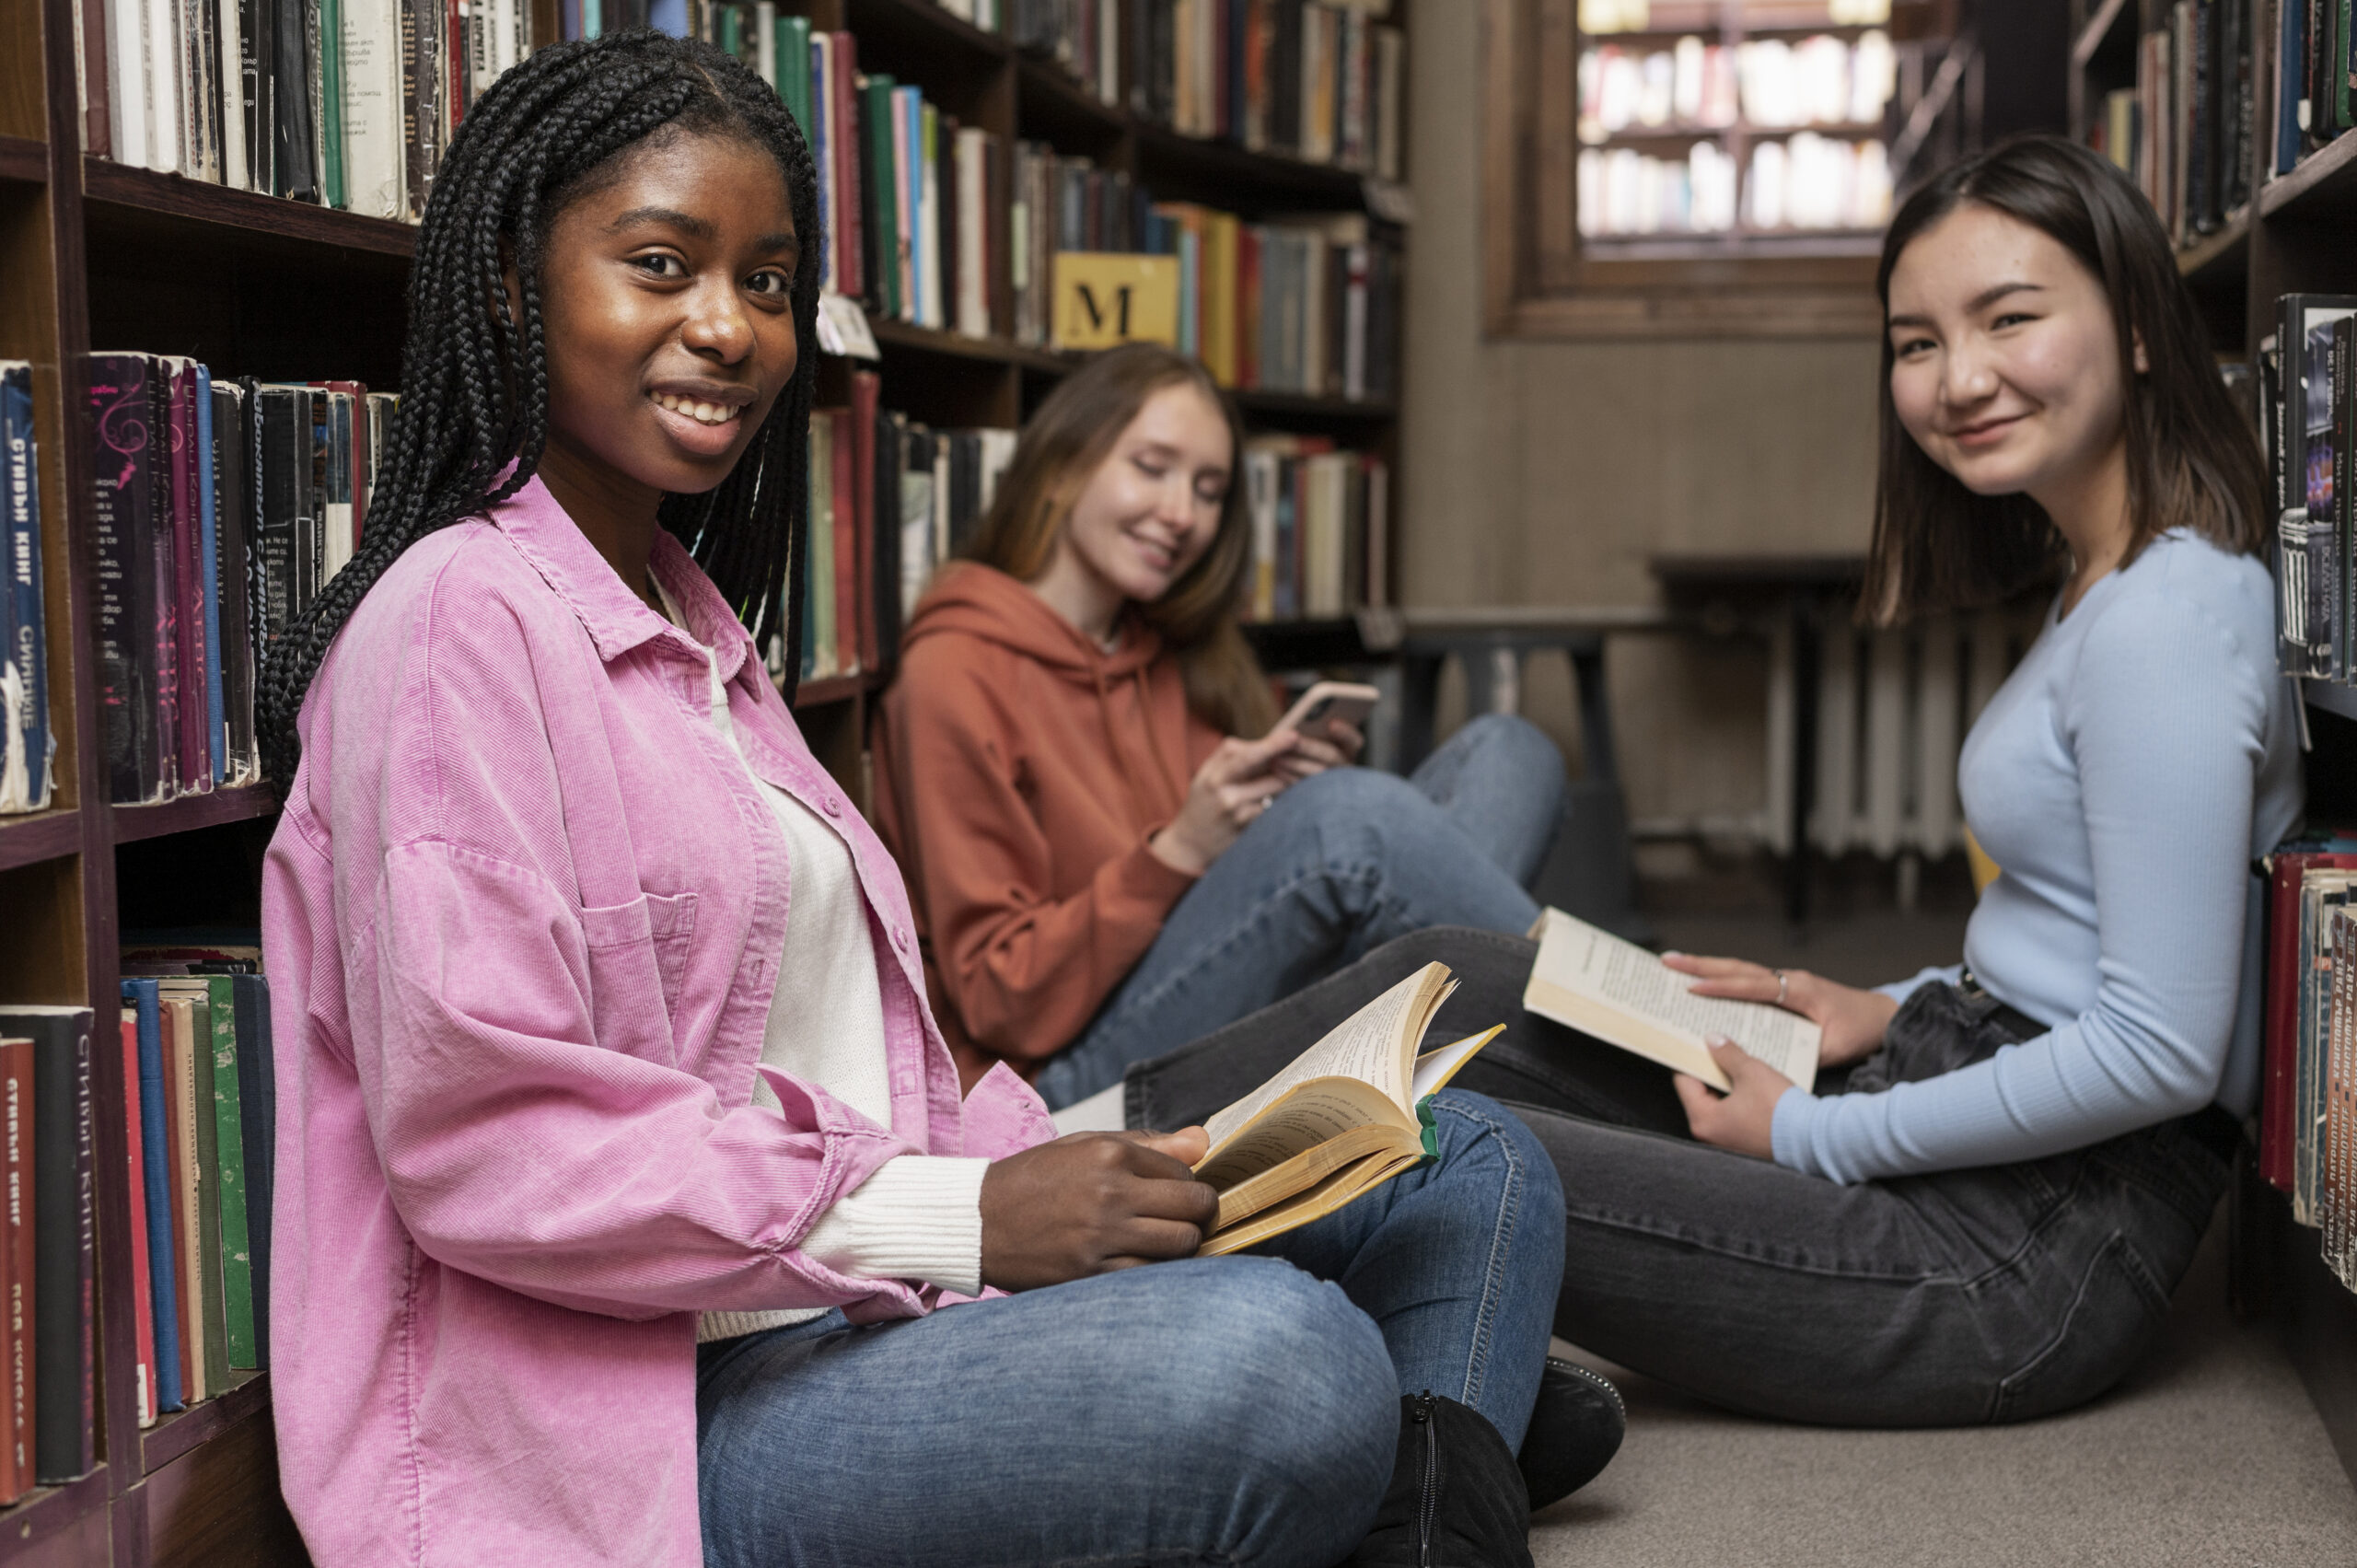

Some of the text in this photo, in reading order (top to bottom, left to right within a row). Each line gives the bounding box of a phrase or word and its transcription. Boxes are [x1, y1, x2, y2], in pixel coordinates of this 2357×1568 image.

[10, 438, 38, 730] СТИВЪН КИНГ СИЯНИЕ
[2335, 957, 2344, 994] РАЙХ
[2332, 999, 2343, 1078] КРИСТОФЪР
[2340, 1107, 2350, 1191] ПАТРИОТИТЕ
[2345, 963, 2354, 1002] РАЙХ
[6, 1078, 19, 1163] СТИВЪН
[77, 1033, 93, 1253] СТИВЪН КИНГ
[2329, 1098, 2339, 1181] ПАТРИОТИТЕ
[9, 1166, 22, 1227] КИНГ
